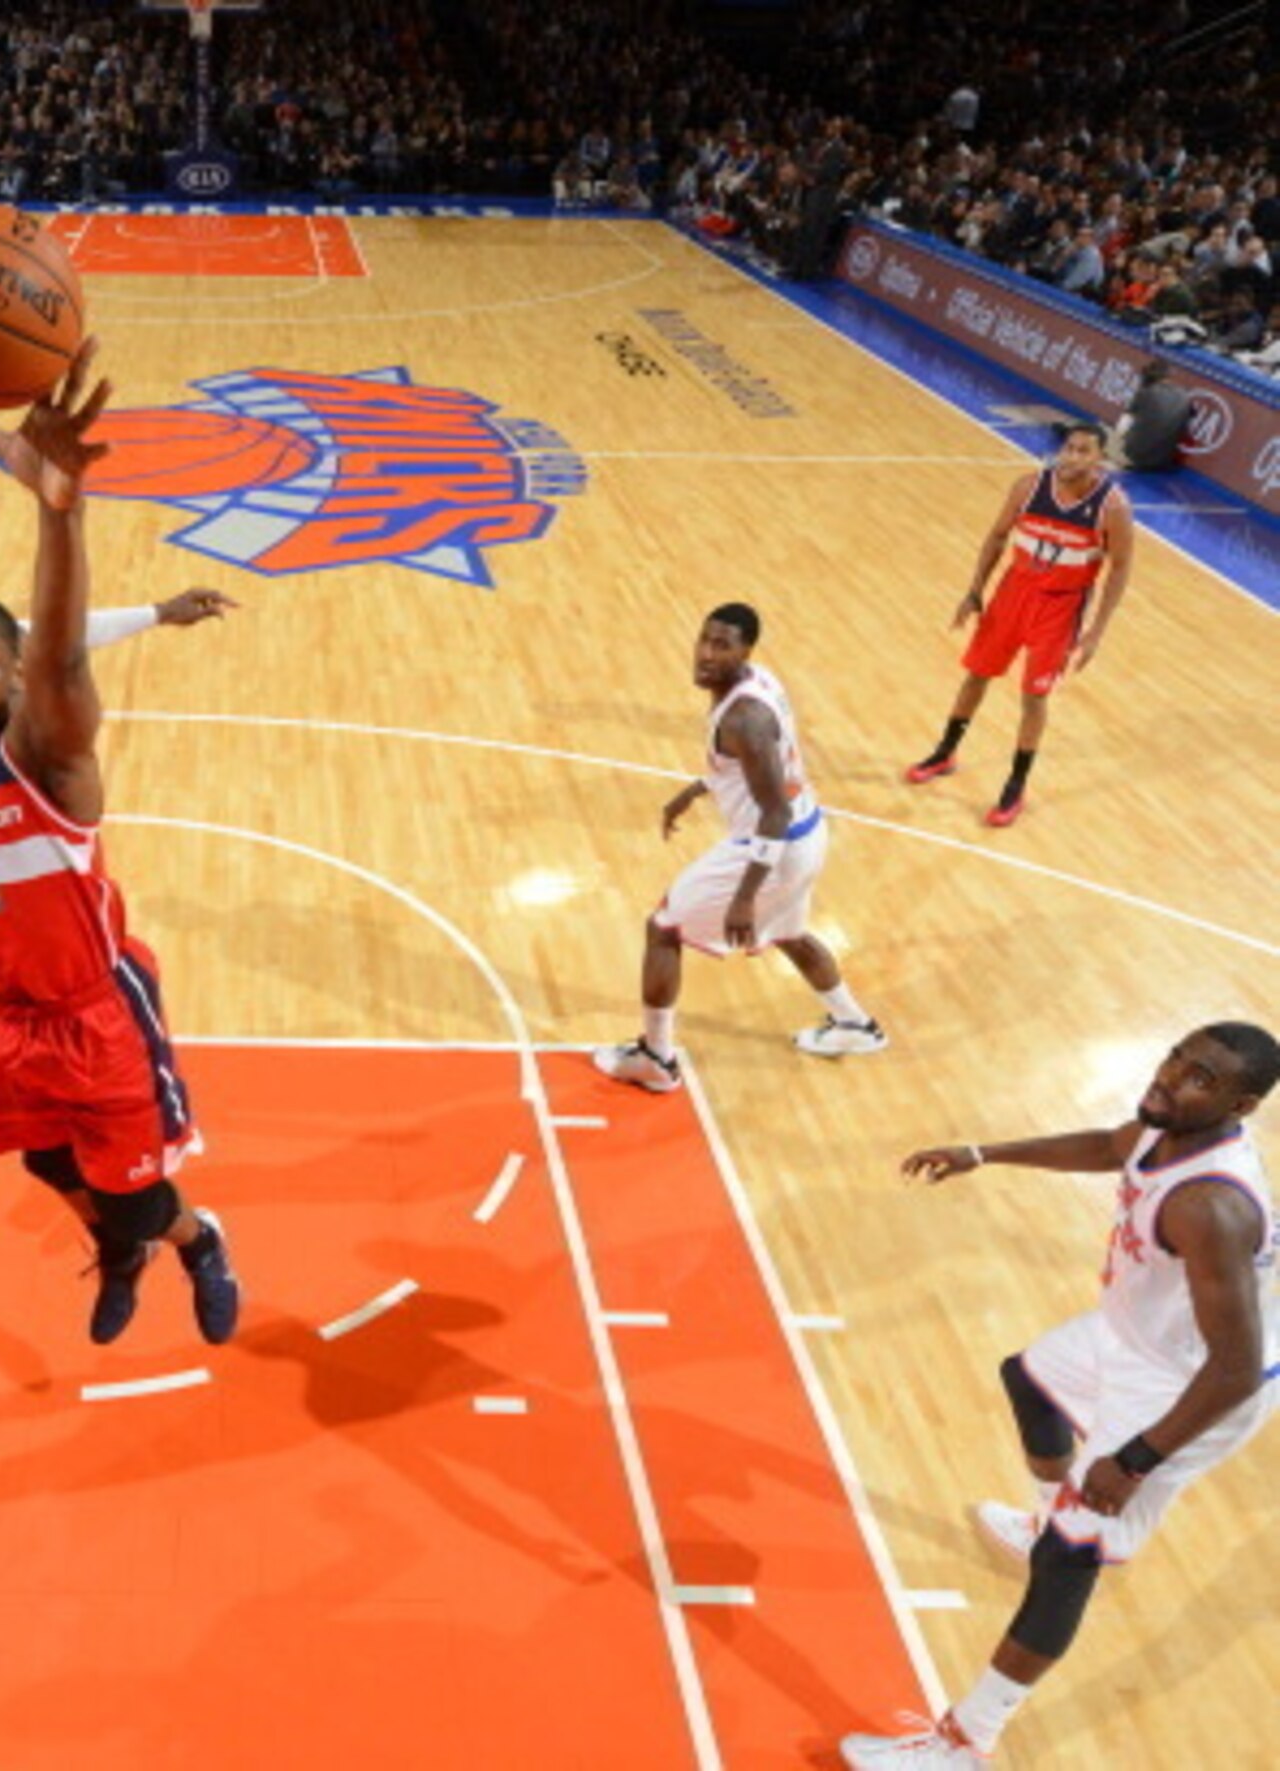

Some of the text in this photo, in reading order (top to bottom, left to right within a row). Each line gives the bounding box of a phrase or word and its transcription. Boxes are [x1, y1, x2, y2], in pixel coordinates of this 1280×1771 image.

[946, 287, 995, 337] Official
[993, 306, 1048, 363] Vehicle
[1042, 336, 1074, 370] of
[1064, 345, 1100, 389] the
[246, 366, 558, 574] KNICKS
